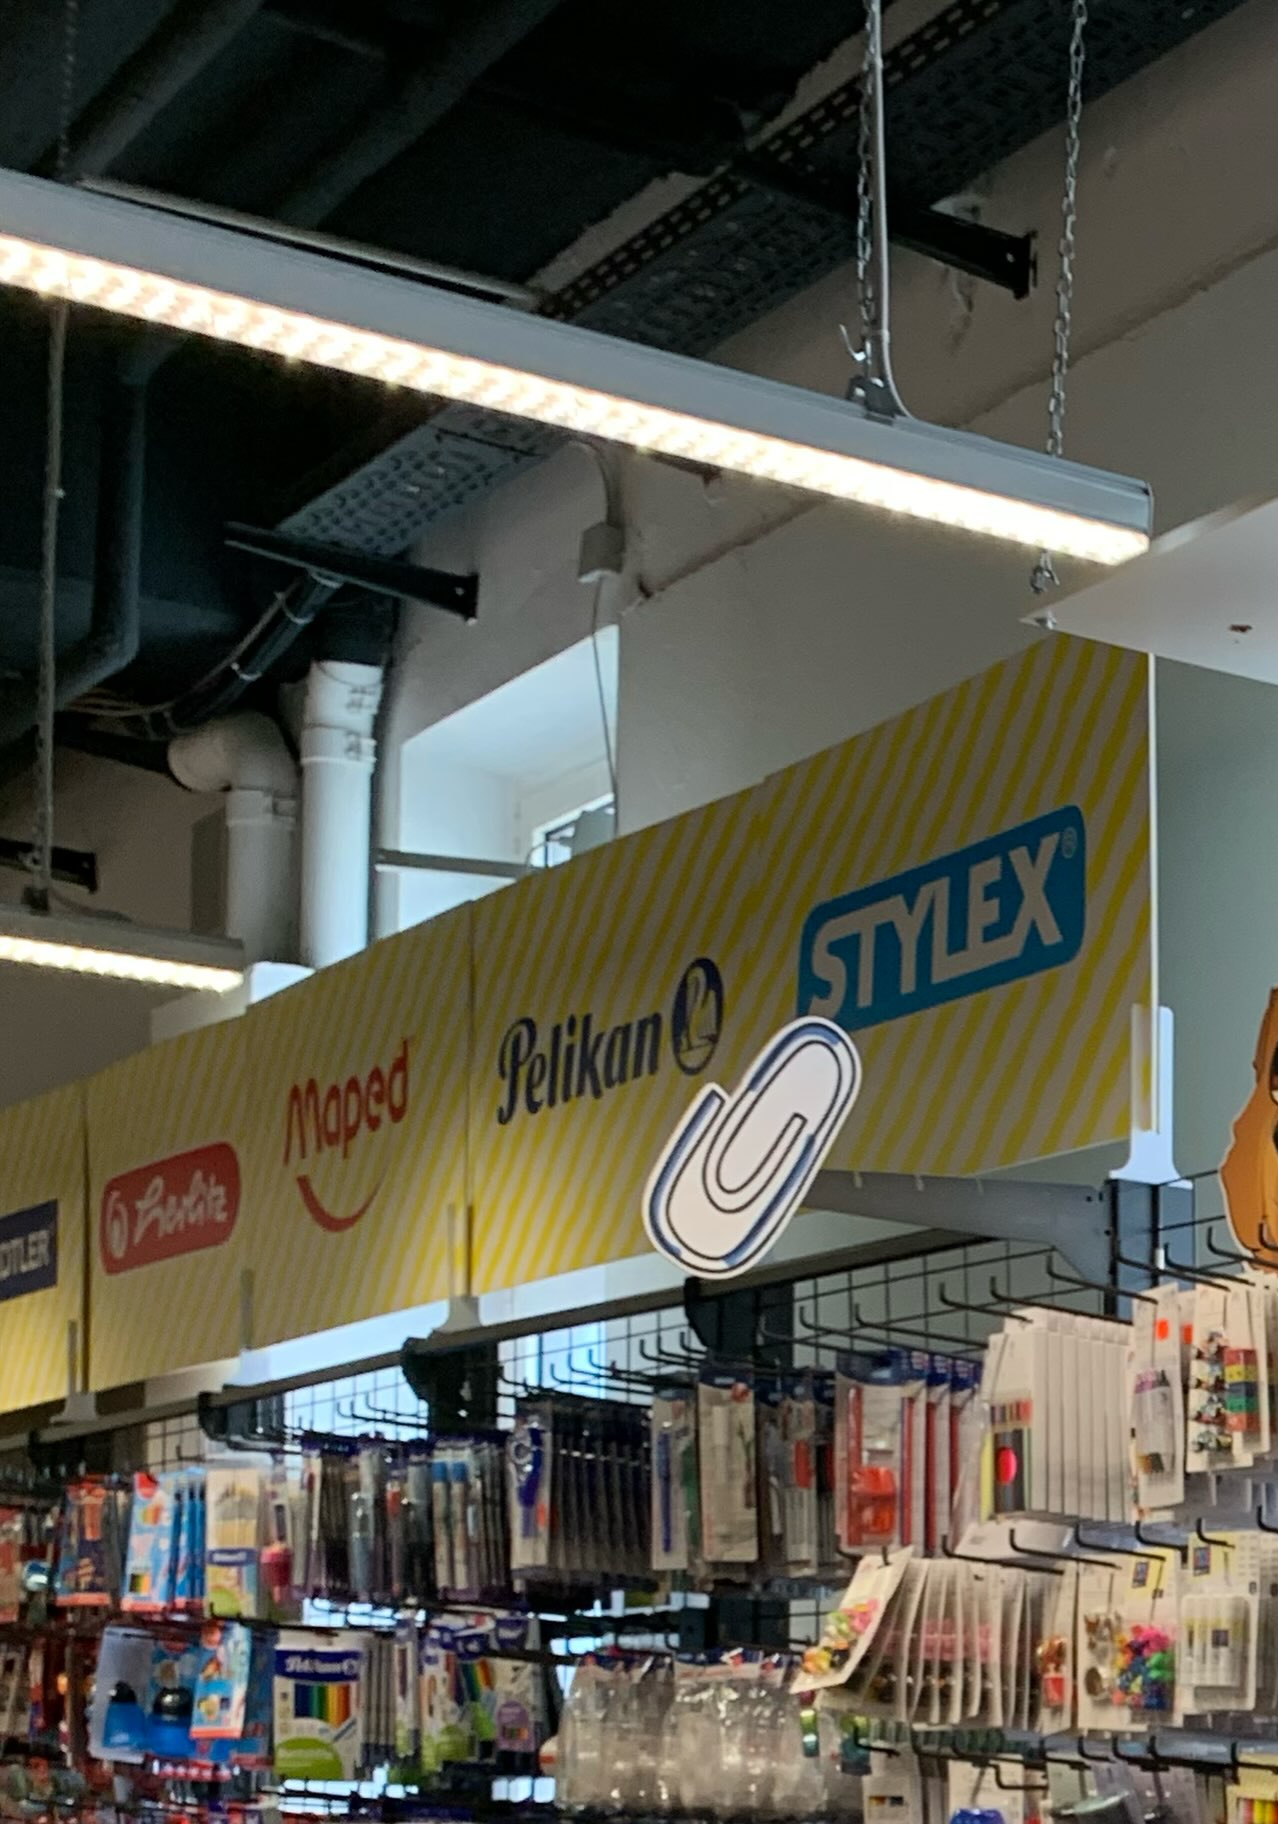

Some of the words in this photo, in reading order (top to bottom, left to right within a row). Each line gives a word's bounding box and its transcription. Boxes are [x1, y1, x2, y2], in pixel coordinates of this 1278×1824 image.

[808, 831, 1064, 1020] STYLEX
[284, 1036, 409, 1167] Maped
[497, 1012, 663, 1125] Pelikan
